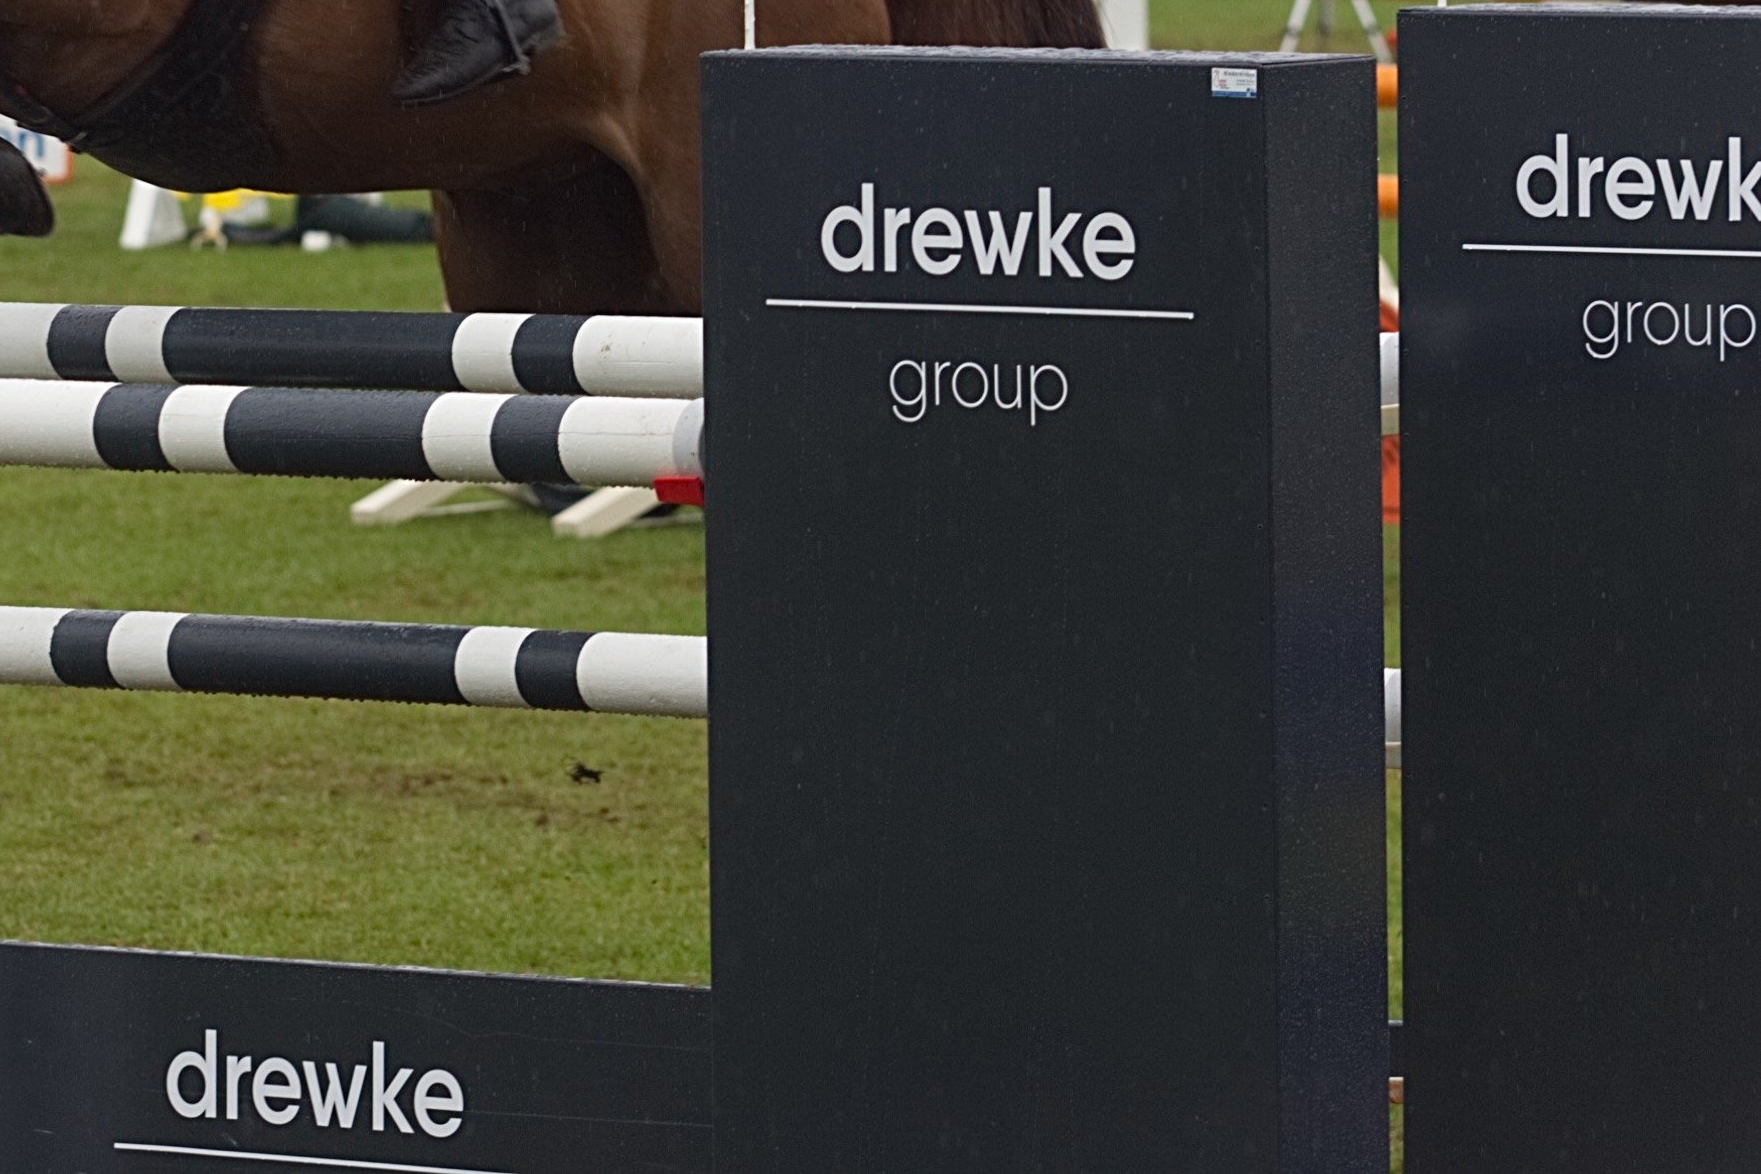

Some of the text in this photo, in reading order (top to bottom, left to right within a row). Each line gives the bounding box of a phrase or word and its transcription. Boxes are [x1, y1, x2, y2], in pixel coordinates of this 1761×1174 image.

[821, 183, 1136, 280] drewke
[1583, 299, 1757, 362] group
[889, 359, 1068, 426] group
[166, 1029, 464, 1138] drewke
